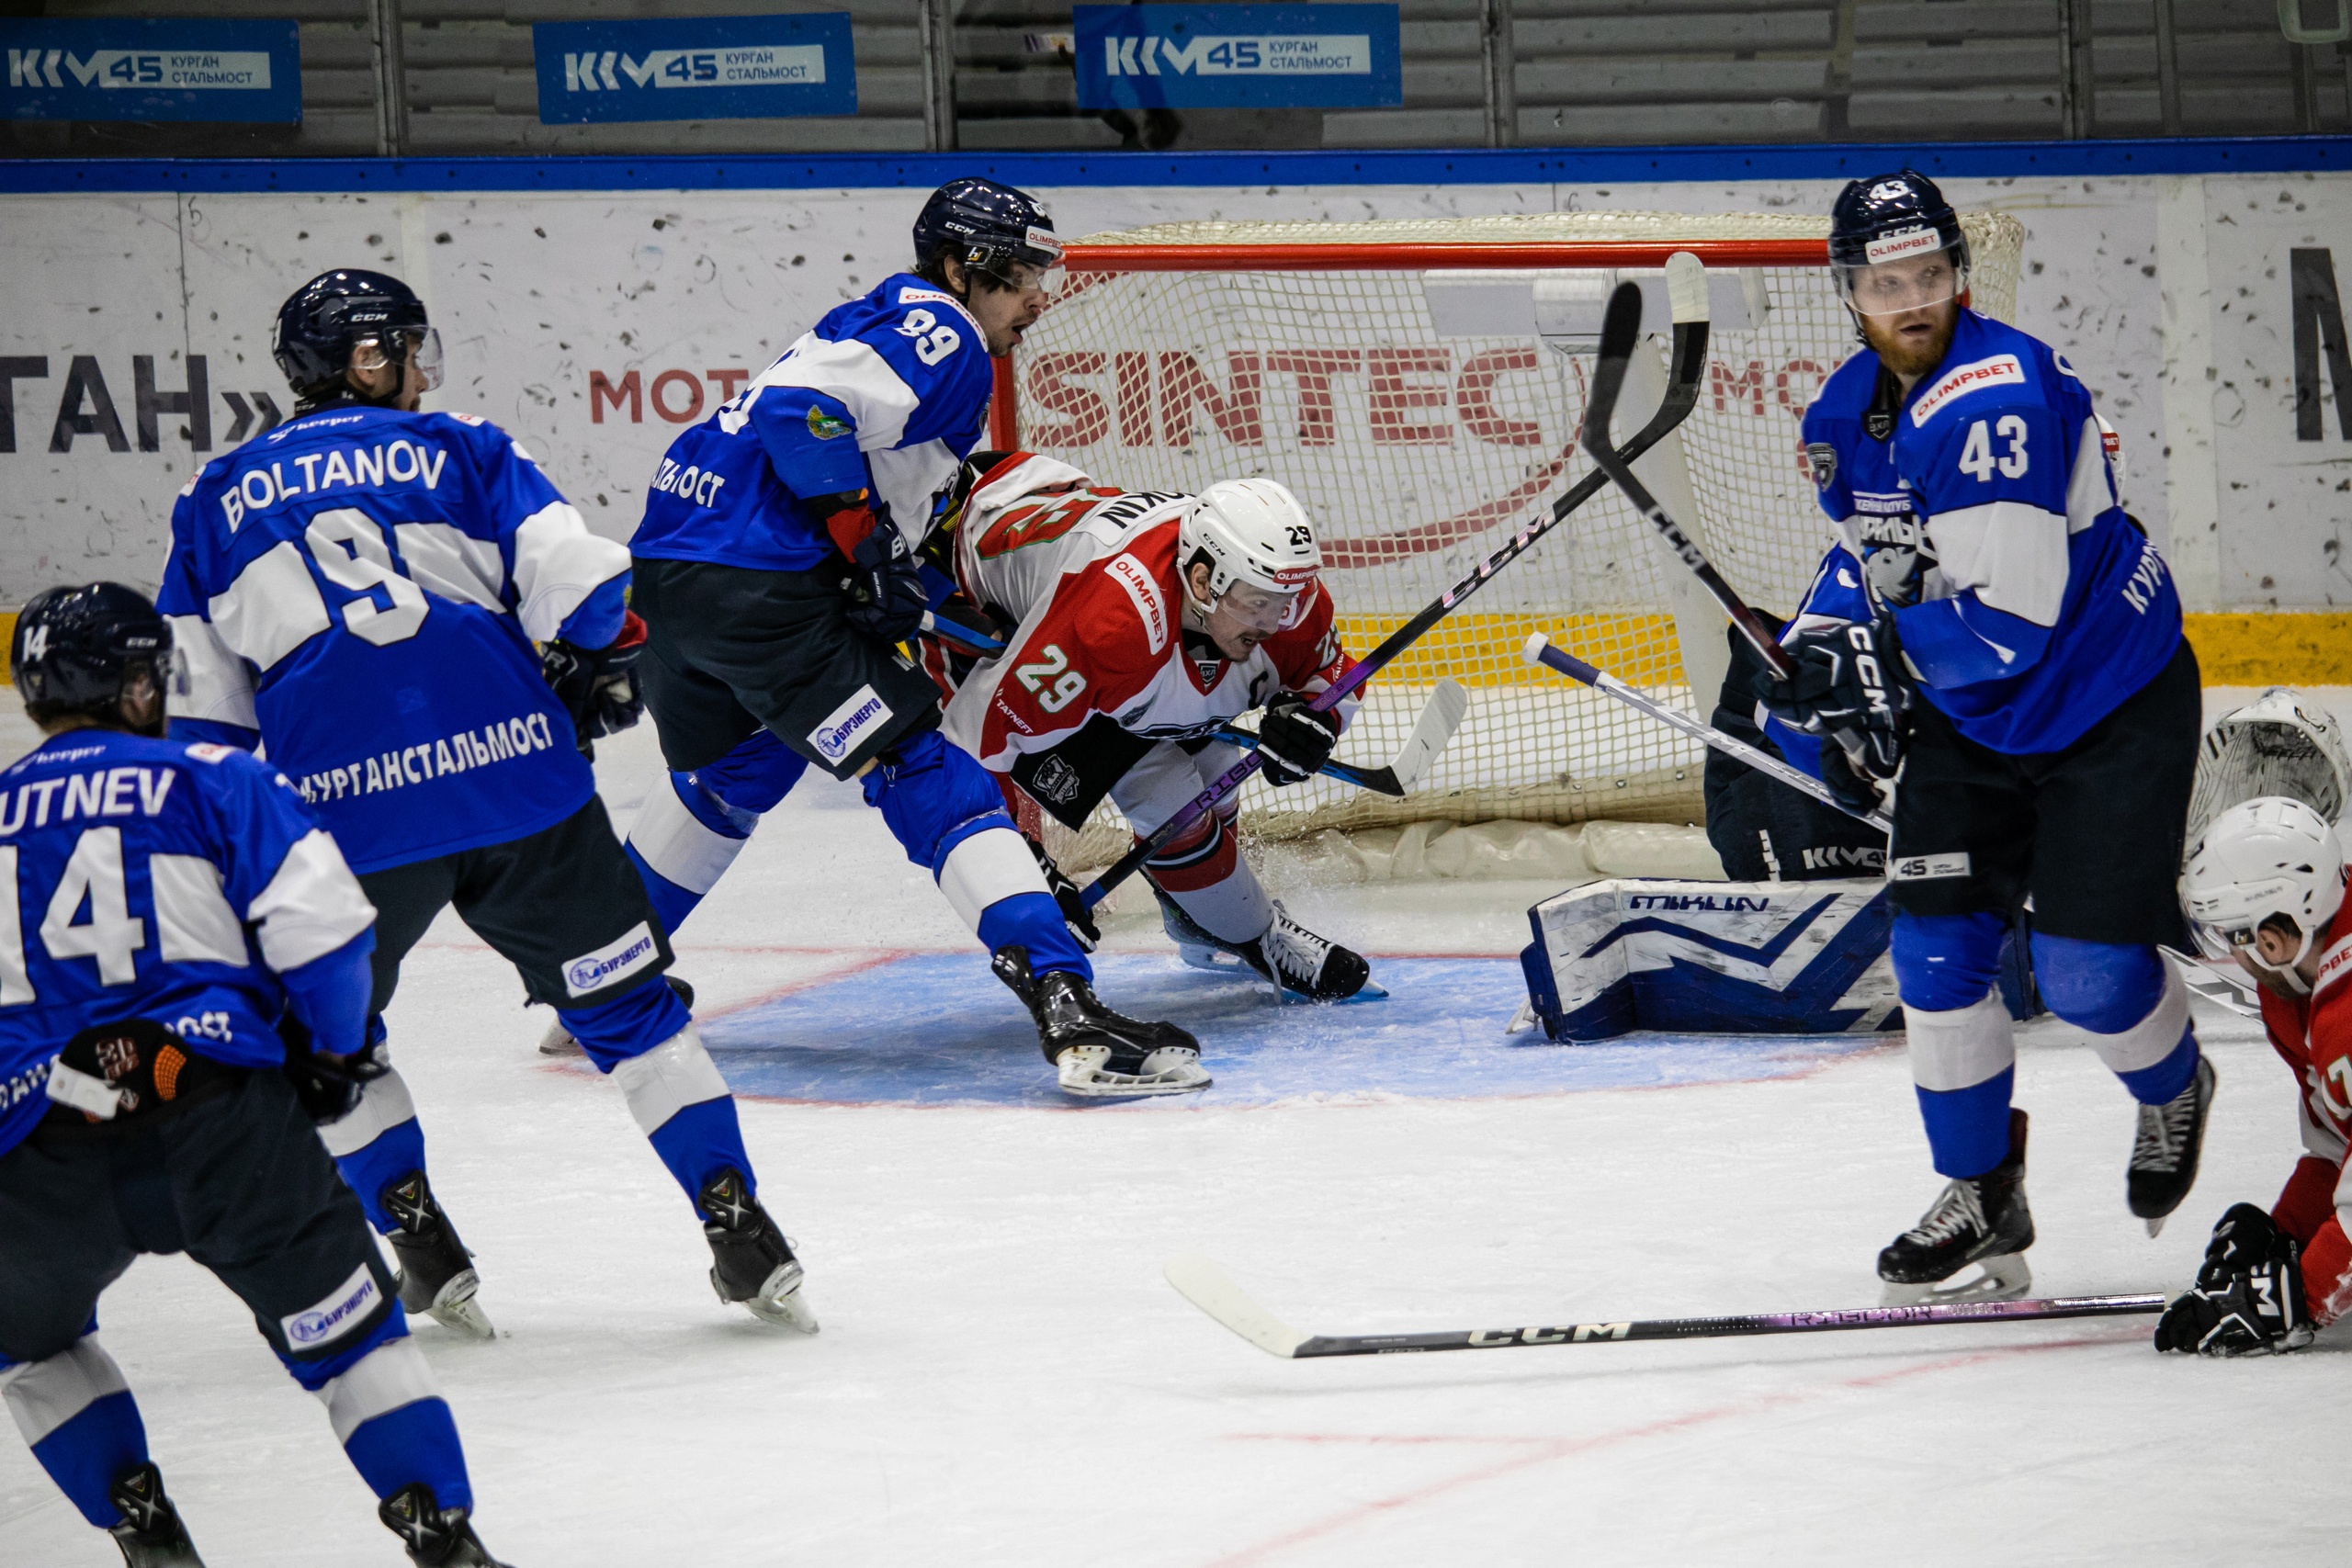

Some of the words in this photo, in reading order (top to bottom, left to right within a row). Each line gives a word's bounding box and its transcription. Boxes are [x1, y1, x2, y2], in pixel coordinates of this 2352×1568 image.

[171, 55, 219, 69] КУРГАН
[726, 52, 774, 65] КУРГАН
[1269, 41, 1317, 53] КУРГАН
[1270, 56, 1351, 70] СТАЛЬМОСТ
[172, 71, 254, 84] СТАЛЬМОСТ
[727, 66, 807, 80] СТАЛЬМОСТ
[1868, 180, 1910, 200] 43
[944, 220, 977, 235] CCM
[1029, 232, 1061, 248] OLIMPBET
[1870, 234, 1936, 257] OLIMPBET
[351, 313, 388, 322] CCM
[892, 308, 961, 367] 89
[1028, 348, 1542, 447] SINTEC
[1917, 362, 2015, 417] OLIMPBET
[1958, 414, 2030, 483] 43
[220, 439, 447, 535] BOLTANOV
[1203, 533, 1226, 557] CCM
[1285, 525, 1312, 546] 29
[1649, 511, 1707, 574] CCM
[1442, 504, 1556, 609] CCM
[305, 507, 430, 647] 9
[1115, 561, 1165, 644] OLIMPBET
[22, 625, 49, 662] 14
[1014, 644, 1088, 714] 29
[1201, 669, 1216, 678] ВХЛ
[1847, 626, 1890, 713] CCM
[836, 698, 881, 740] БУРЭНЕРГО
[996, 698, 1034, 735] TATNEFT
[0, 767, 175, 837] UTNEV
[1900, 859, 1927, 876] 45
[0, 826, 145, 1006] 14
[600, 936, 651, 974] БУРЭНЕРГО
[1467, 1321, 1633, 1348] CCM
